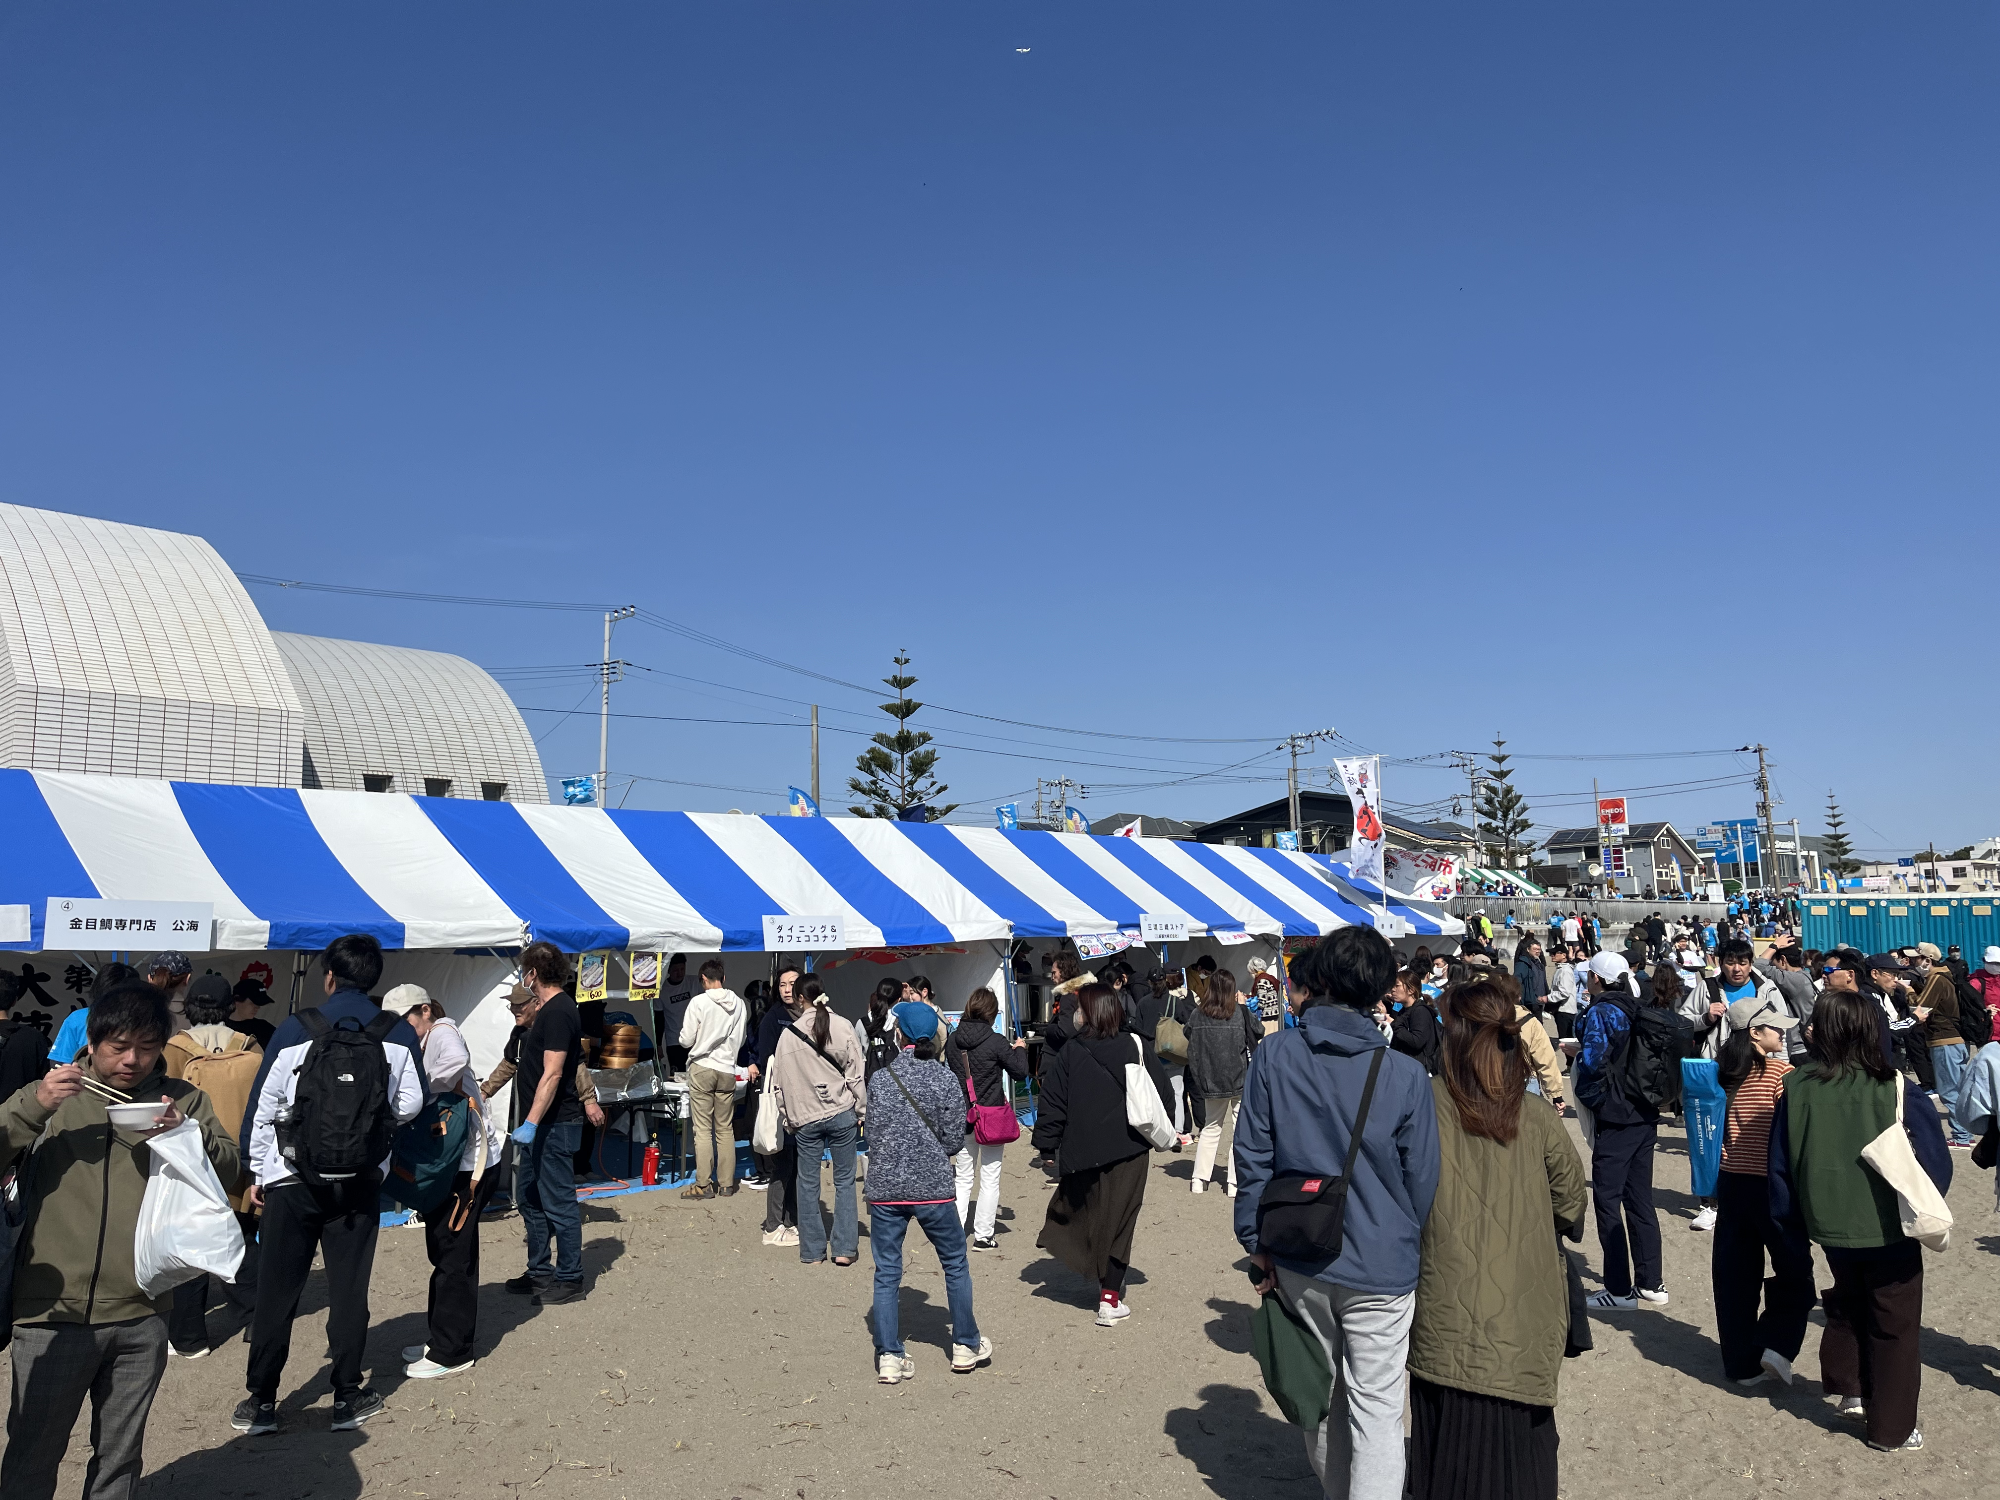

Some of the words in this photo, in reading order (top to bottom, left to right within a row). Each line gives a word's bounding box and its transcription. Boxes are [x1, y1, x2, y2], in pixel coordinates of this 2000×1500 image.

[1601, 807, 1623, 815] ENEOS
[69, 917, 157, 932] 金目鯛専門店
[172, 919, 200, 932] 公海
